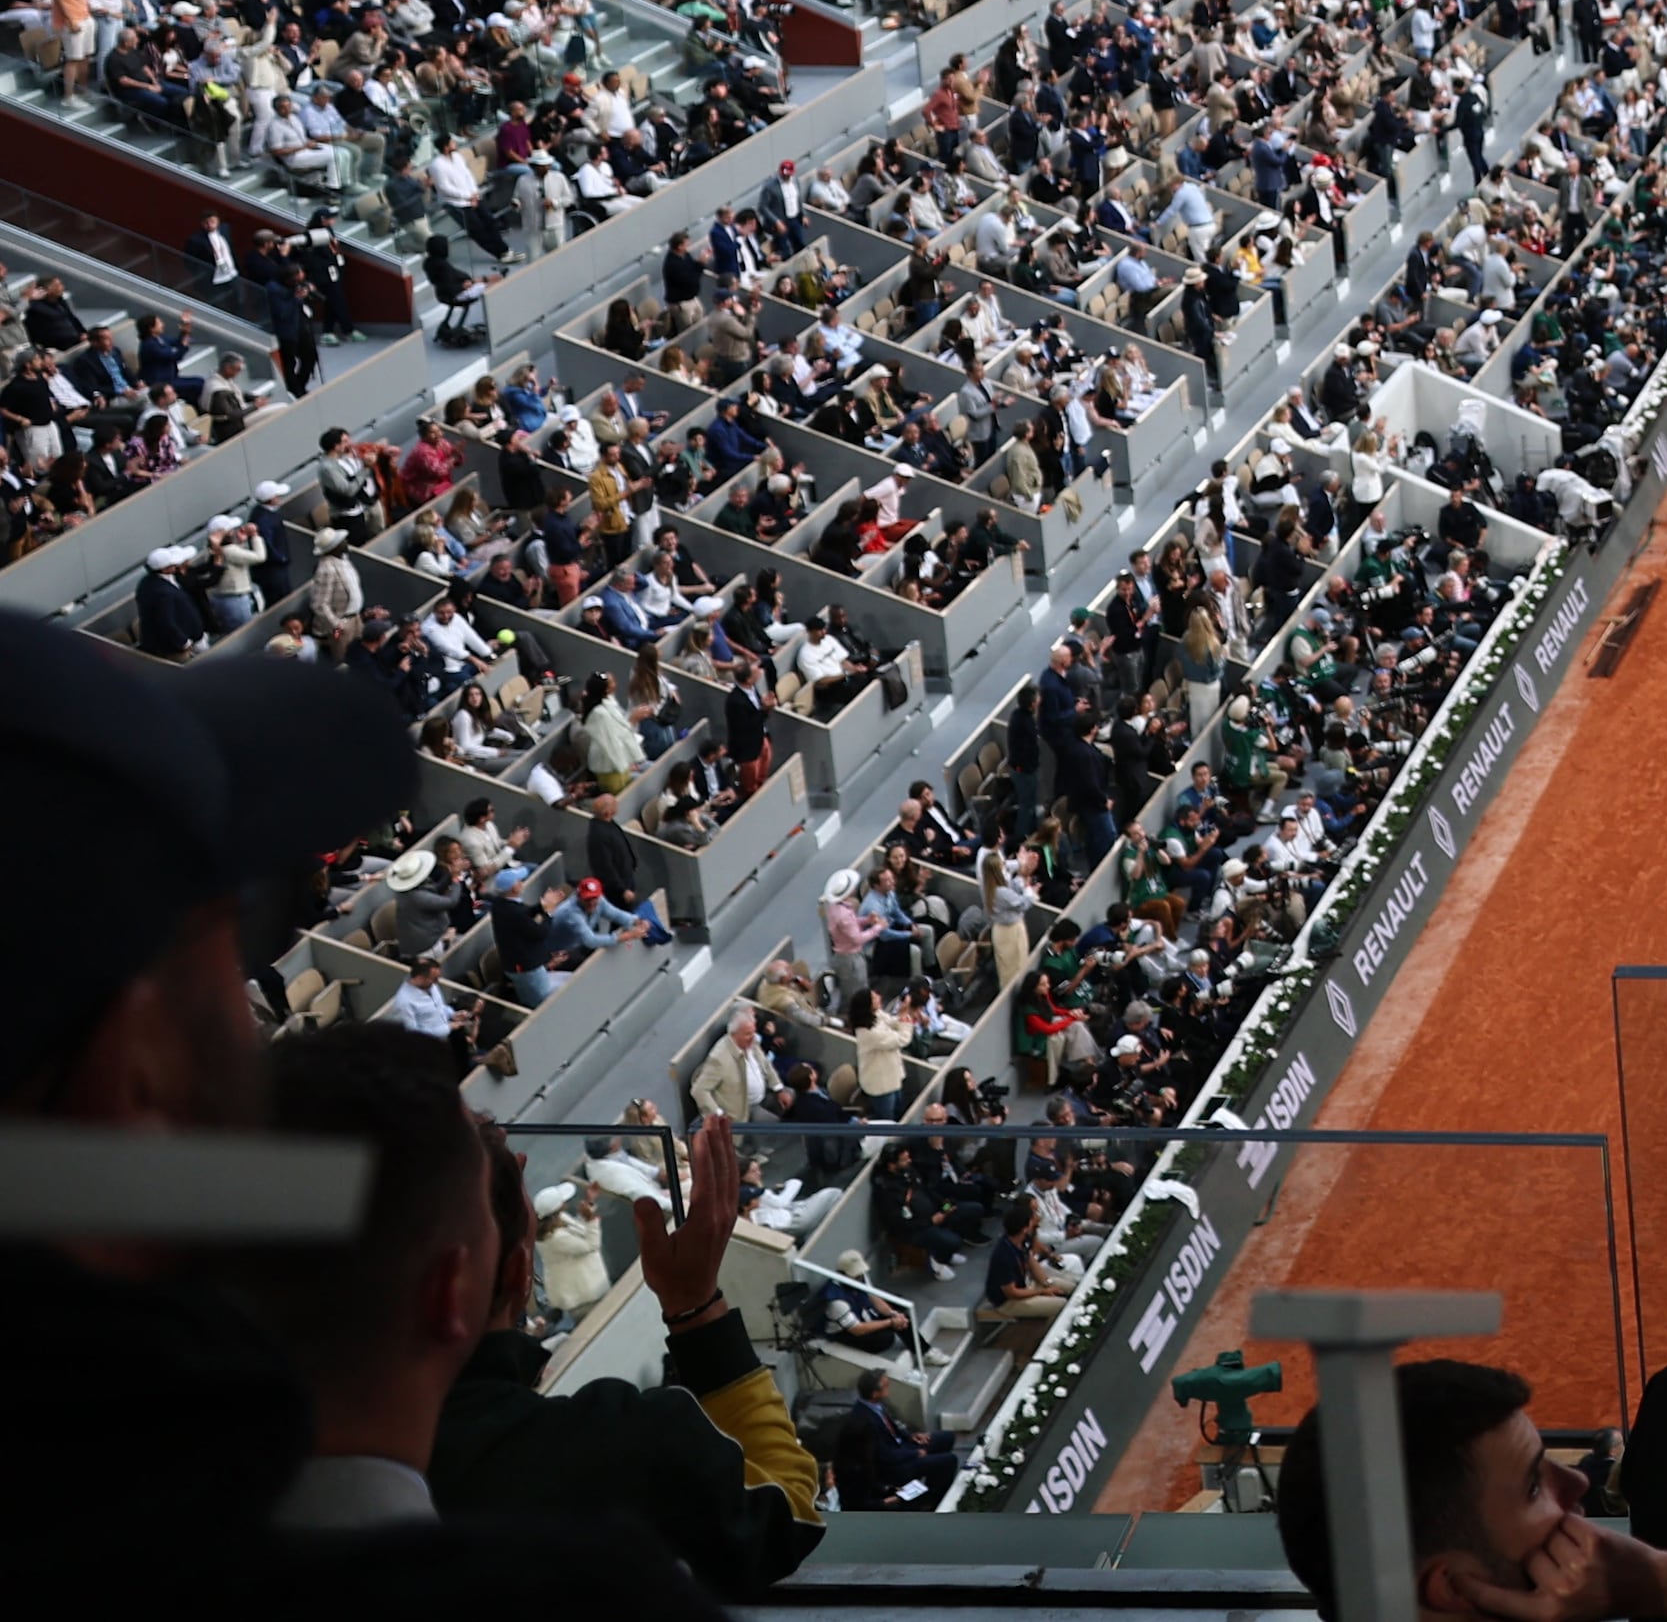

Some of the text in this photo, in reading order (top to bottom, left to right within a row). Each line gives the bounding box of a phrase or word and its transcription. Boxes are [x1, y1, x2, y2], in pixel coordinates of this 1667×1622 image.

[1534, 577, 1589, 675] RENAULT
[1451, 701, 1515, 816] RENAULT
[1353, 850, 1428, 986] RENAULT
[1264, 1051, 1316, 1130] ISDIN
[1163, 1212, 1222, 1315] ISDIN
[1038, 1407, 1108, 1514] ISDIN
